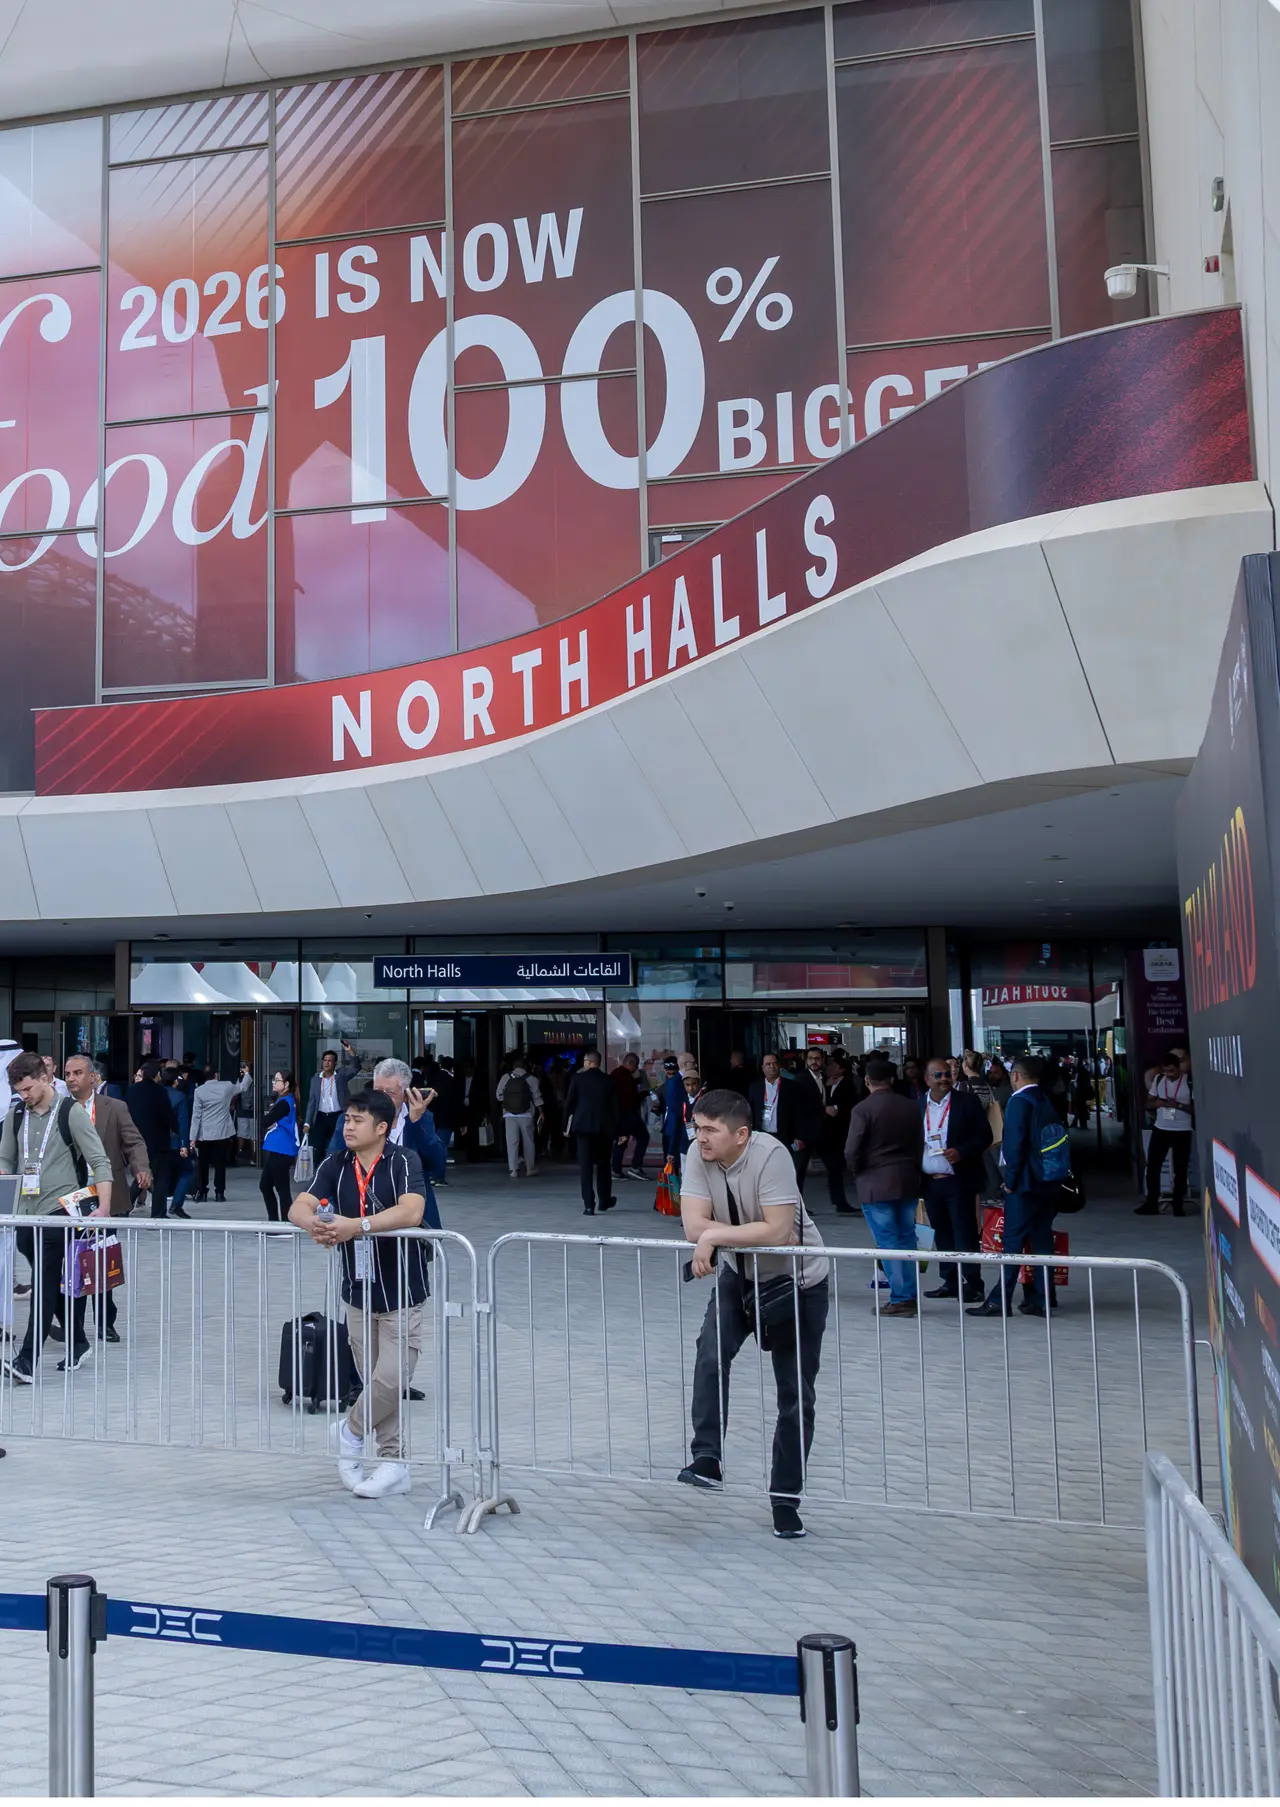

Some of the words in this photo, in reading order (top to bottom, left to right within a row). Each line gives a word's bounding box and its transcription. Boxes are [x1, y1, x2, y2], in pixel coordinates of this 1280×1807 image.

[119, 263, 287, 352] 2026
[314, 244, 381, 319] IS
[409, 206, 584, 304] NOW
[332, 630, 589, 762] NORTH
[625, 494, 840, 688] HALLS
[1185, 806, 1256, 1013] THAILAND
[383, 964, 423, 979] North
[427, 963, 462, 978] Halls
[516, 963, 570, 980] الشمالية
[573, 962, 621, 977] القاعات
[129, 1604, 223, 1643] DEC
[479, 1638, 584, 1676] DEC
